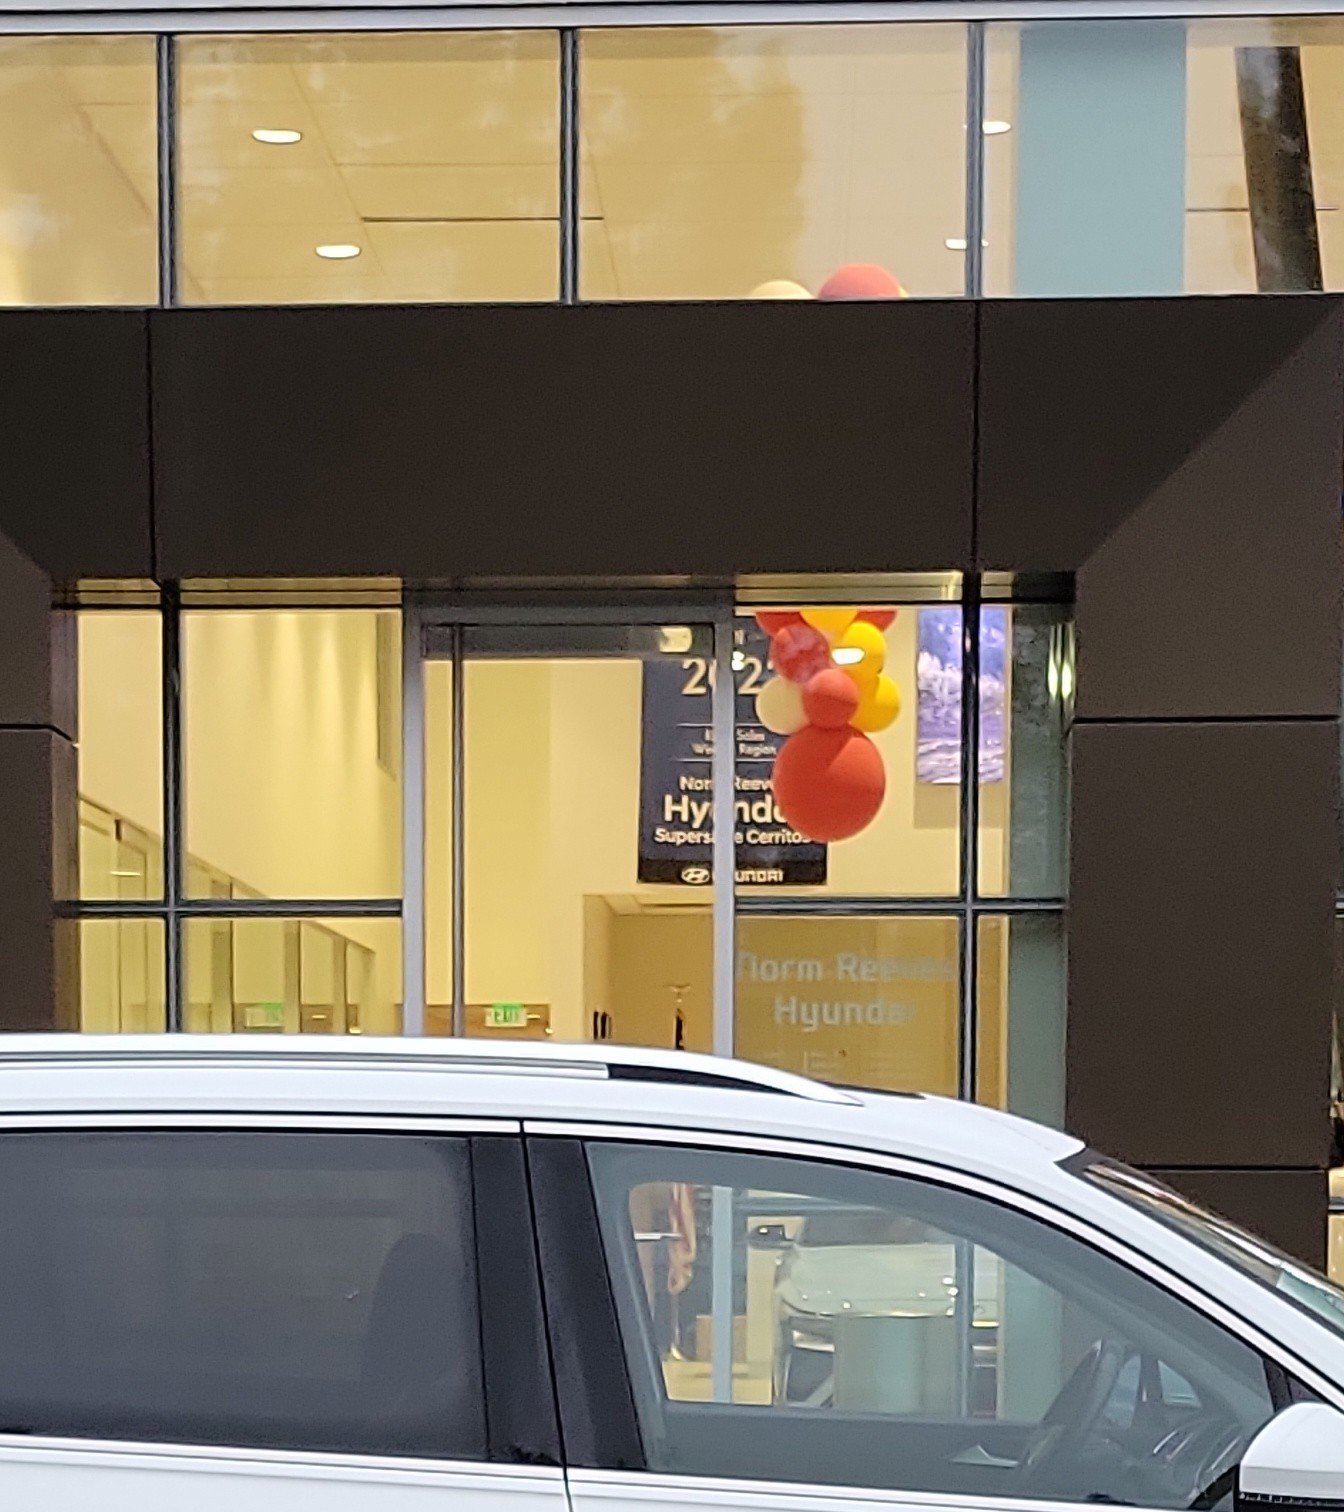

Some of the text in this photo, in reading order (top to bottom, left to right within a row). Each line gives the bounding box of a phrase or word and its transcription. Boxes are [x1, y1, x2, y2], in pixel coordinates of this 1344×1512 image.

[680, 777, 714, 791] Nor
[664, 795, 788, 828] Hynd
[655, 828, 743, 846] Superse
